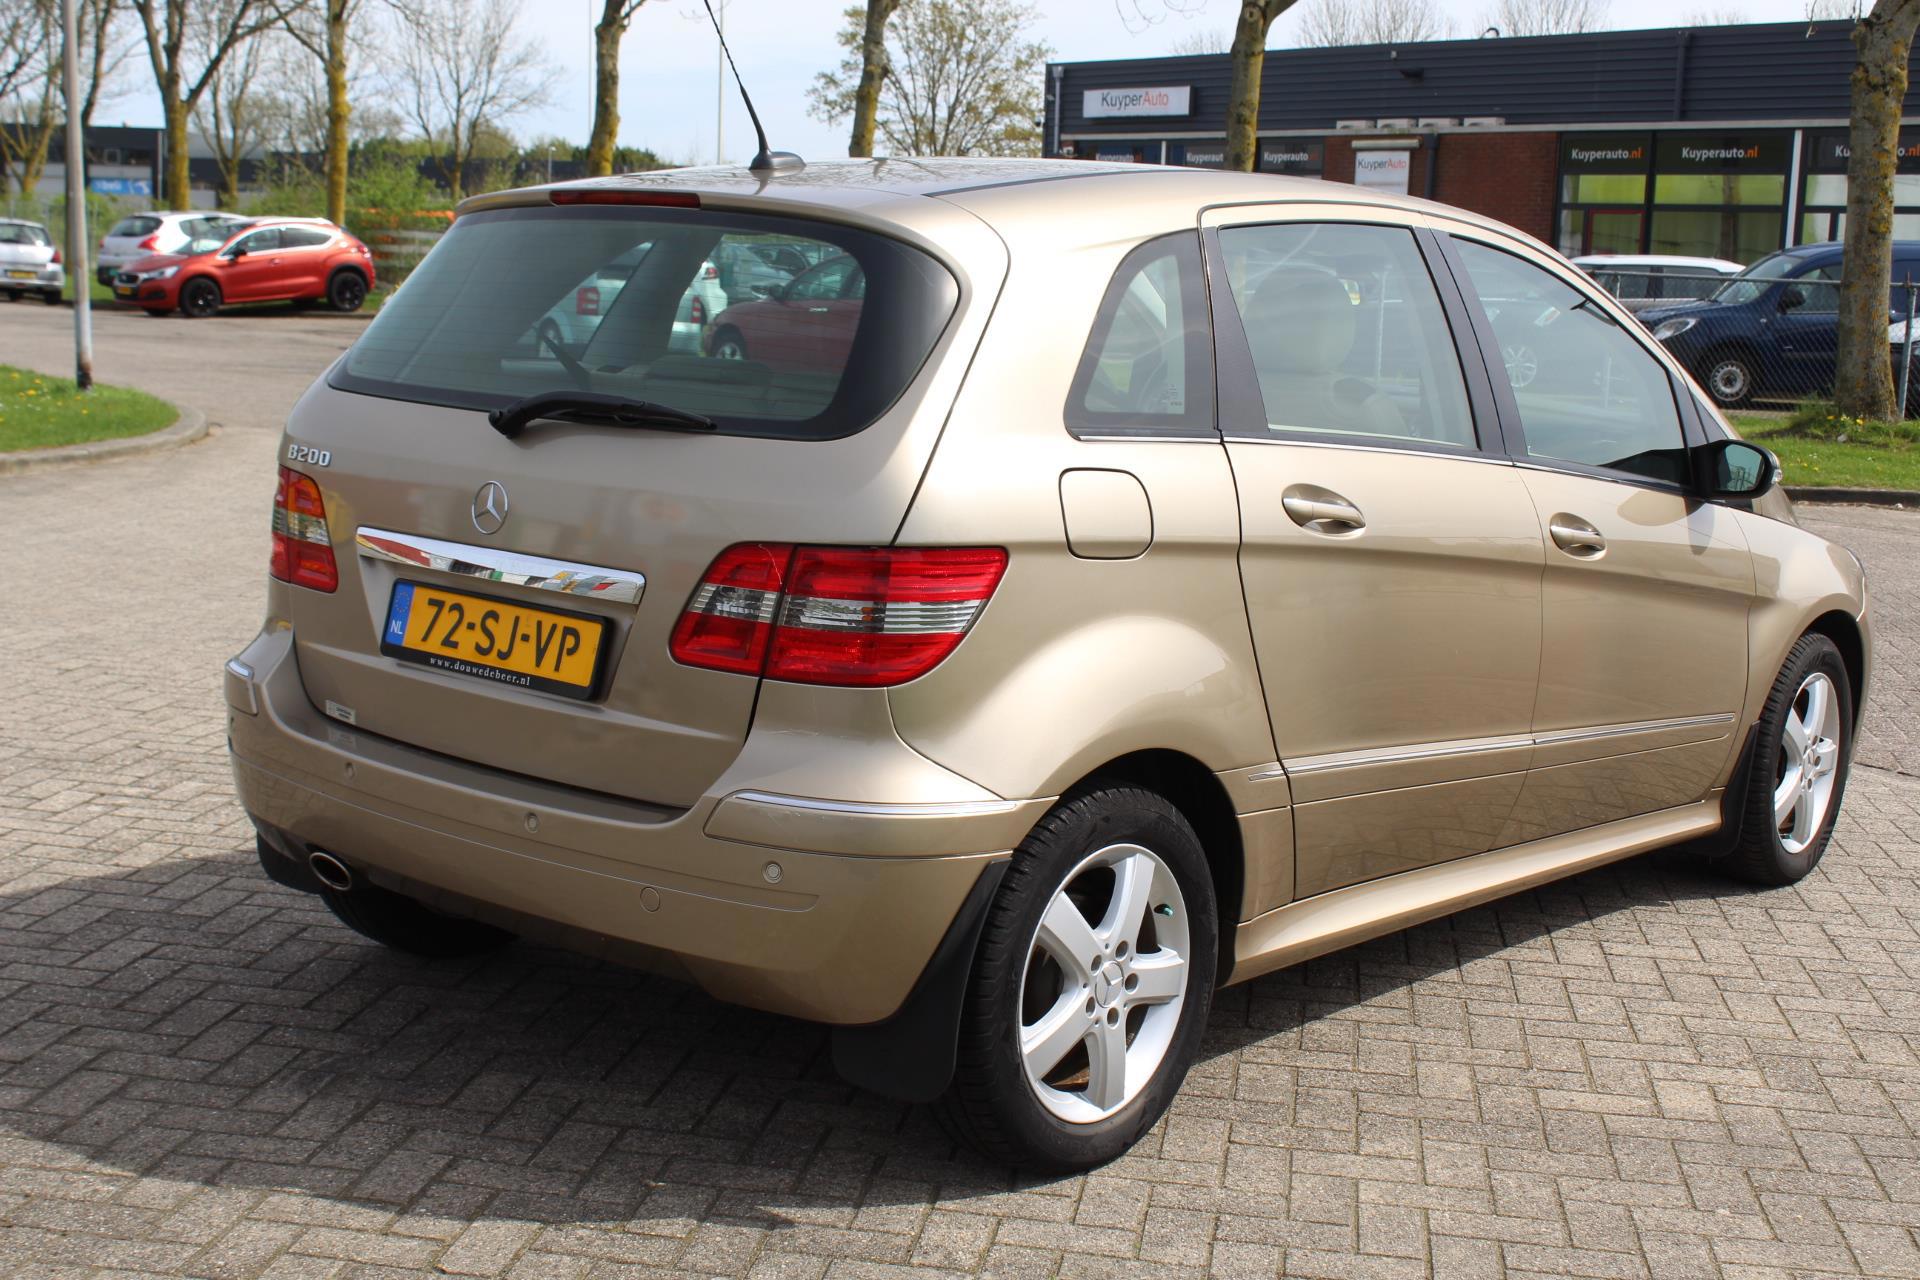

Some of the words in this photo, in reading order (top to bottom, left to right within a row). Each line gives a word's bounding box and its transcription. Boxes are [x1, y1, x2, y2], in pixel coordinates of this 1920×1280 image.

[1101, 91, 1169, 110] KuyperAuto
[1571, 147, 1642, 162] Kuyperauto.nl
[1682, 146, 1760, 161] Kuyperauto.nl
[1357, 158, 1407, 171] KuyperAuto
[288, 444, 331, 467] B200
[390, 619, 403, 635] NL
[421, 597, 581, 673] 72-SJ-VP
[430, 657, 531, 686] www.douwedebeer.nl
